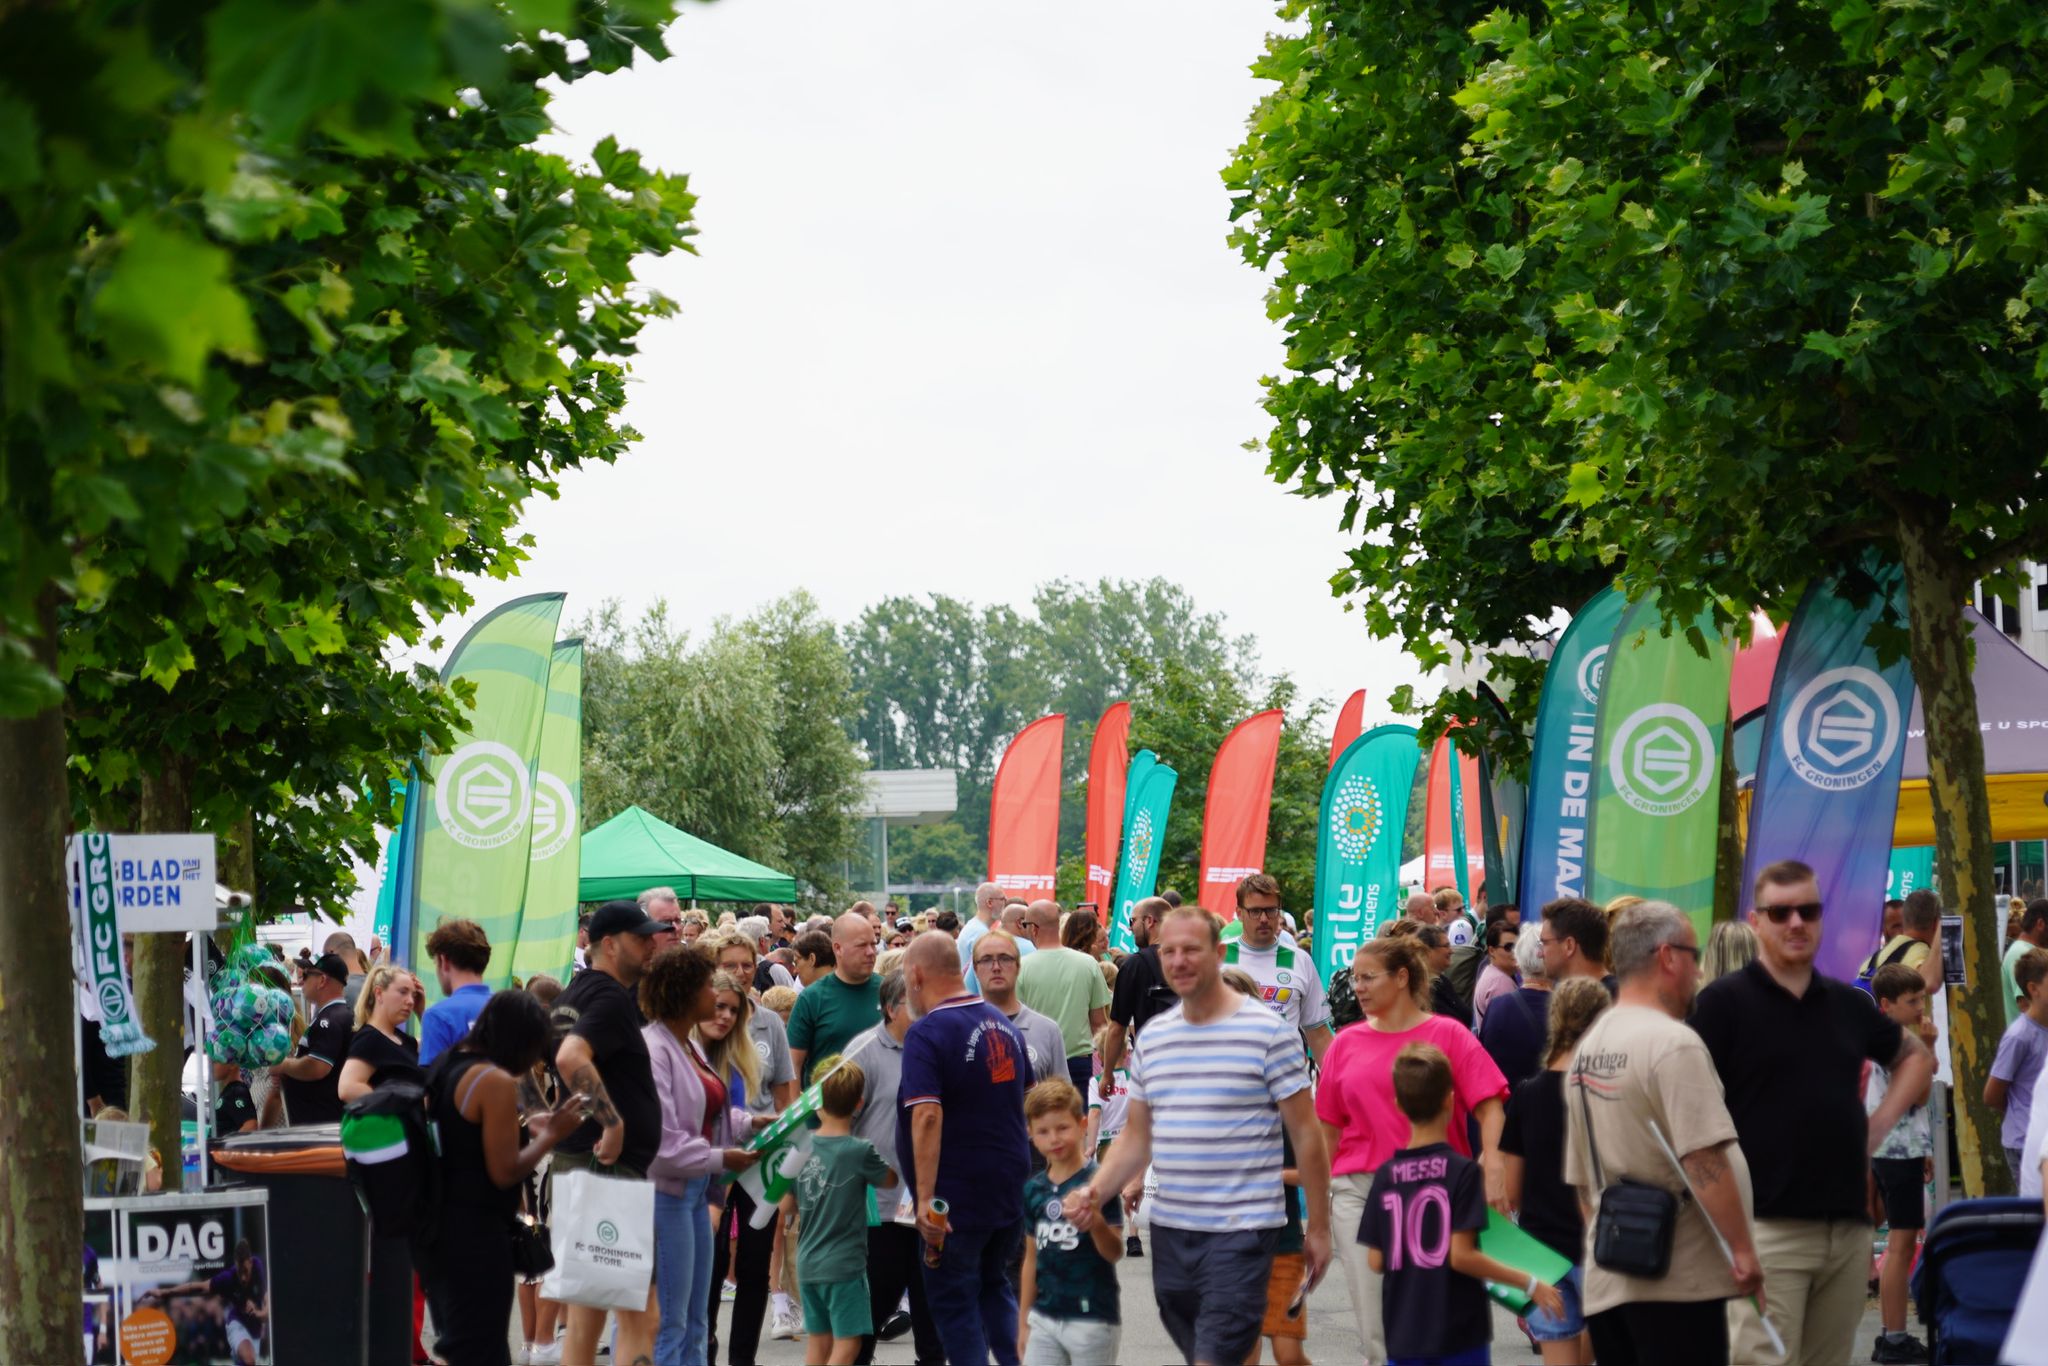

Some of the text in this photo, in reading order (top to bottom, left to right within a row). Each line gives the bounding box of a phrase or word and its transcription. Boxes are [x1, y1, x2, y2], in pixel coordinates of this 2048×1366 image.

[1567, 724, 1595, 762] IN
[1792, 754, 1882, 788] FC GRONINGEN
[1561, 771, 1590, 818] DE
[1619, 784, 1701, 813] FC GRONINGEN
[443, 818, 521, 846] FC GRONINGEN
[531, 837, 566, 858] NINGEN
[114, 859, 180, 882] BLAD
[994, 874, 1055, 889] ESPN
[116, 885, 181, 907] RDEN
[1327, 883, 1363, 967] arle
[1362, 883, 1380, 943] pticiens
[95, 922, 116, 975] FC
[1392, 1157, 1448, 1184] MESSI
[136, 1220, 225, 1262] DAG
[1383, 1185, 1451, 1270] 10
[575, 1241, 642, 1260] FC GRONINGEN
